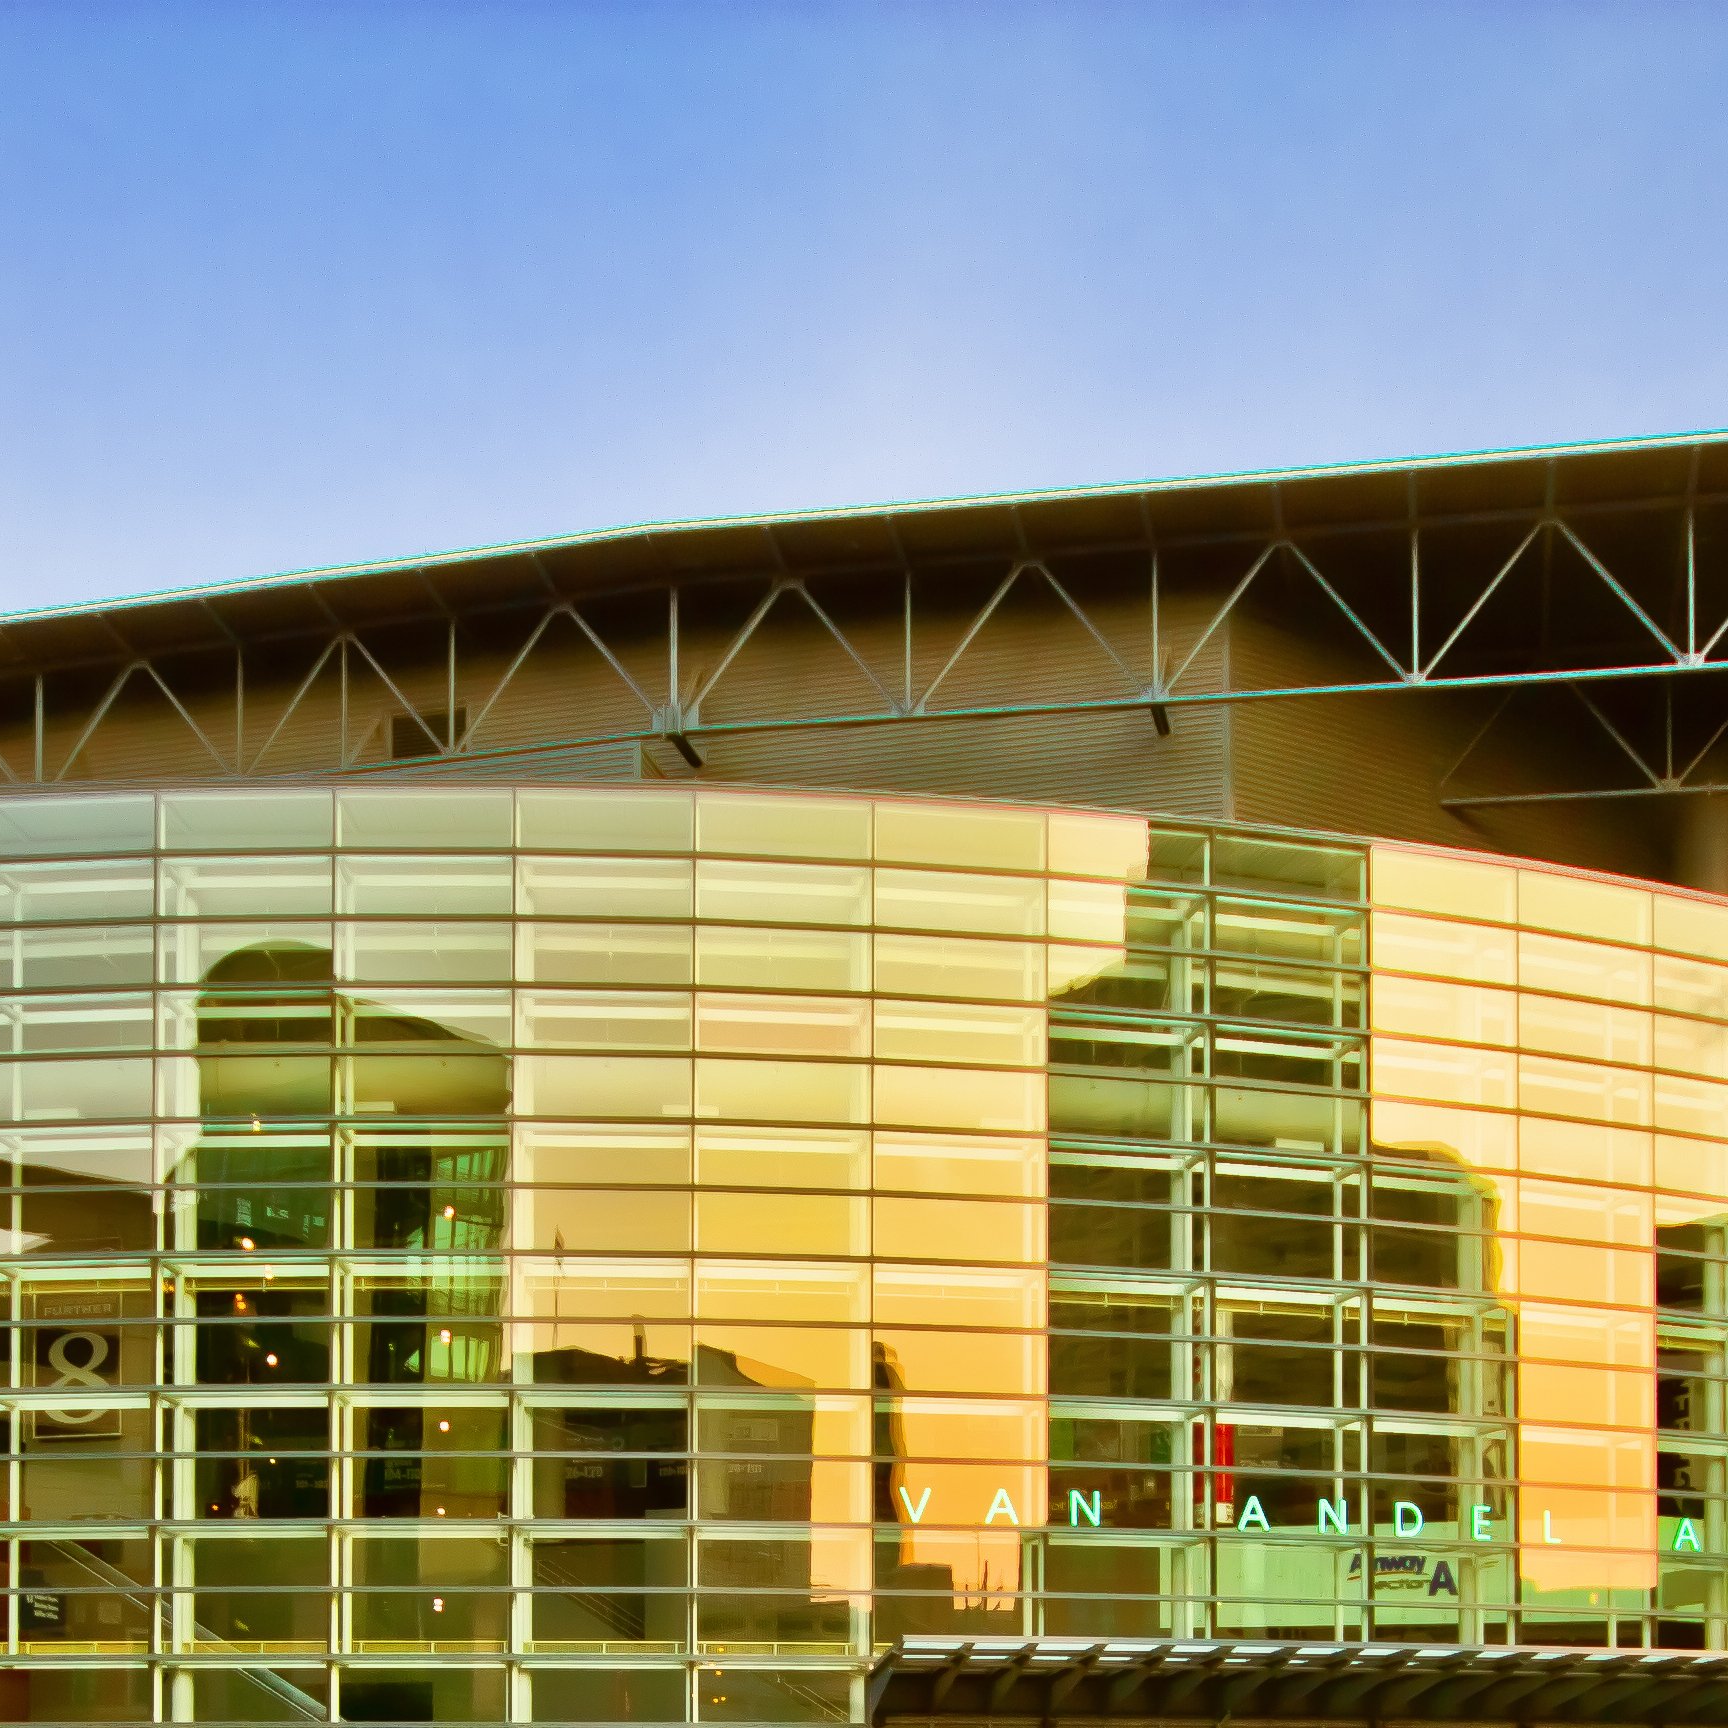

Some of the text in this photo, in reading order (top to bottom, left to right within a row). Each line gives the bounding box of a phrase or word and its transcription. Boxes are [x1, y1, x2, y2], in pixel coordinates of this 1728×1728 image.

[899, 1486, 1102, 1527] VAN
[1237, 1495, 1562, 1544] ANDEL
[1428, 1560, 1459, 1596] A
